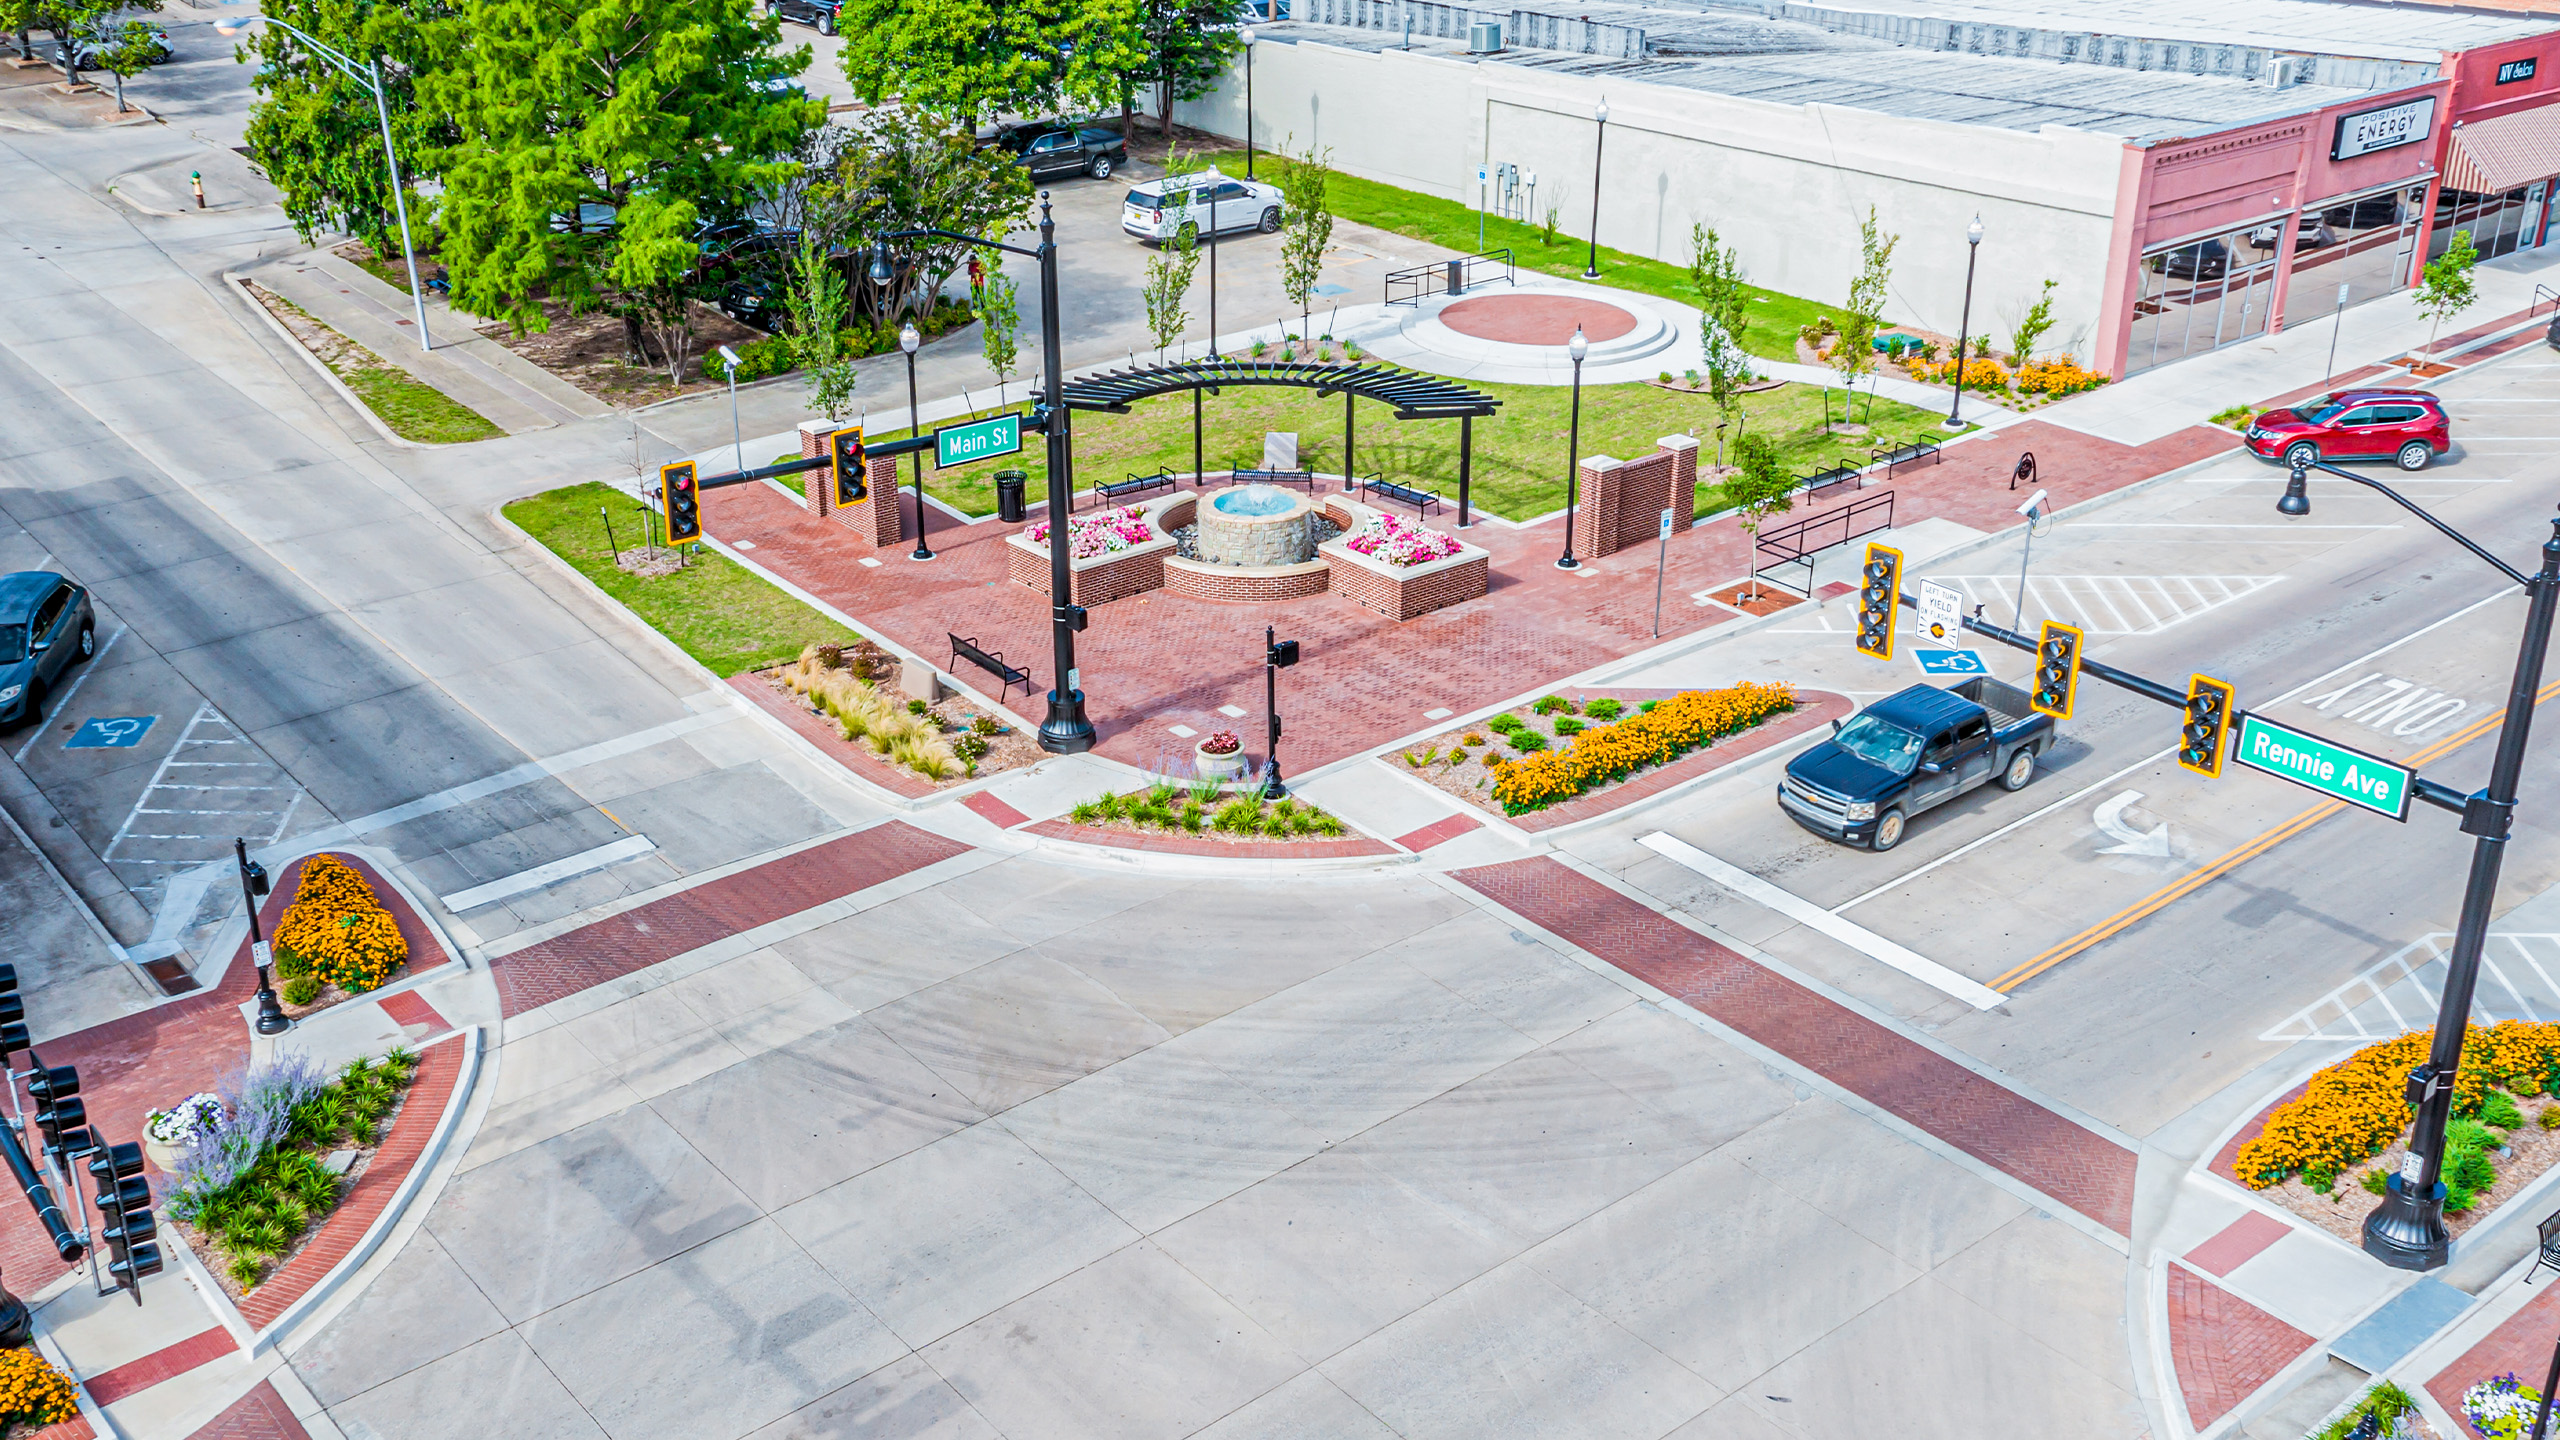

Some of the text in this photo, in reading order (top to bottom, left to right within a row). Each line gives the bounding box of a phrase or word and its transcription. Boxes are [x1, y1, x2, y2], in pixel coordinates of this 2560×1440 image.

[2499, 62, 2533, 81] NV Salon
[2362, 104, 2417, 124] POSITIVE
[2357, 114, 2417, 142] ENERGY
[949, 427, 1009, 456] Main St
[1926, 586, 1958, 602] LEFT TURN
[1930, 598, 1952, 613] YIELD
[1921, 607, 1958, 626] ON FLASHING
[2301, 672, 2467, 736] ONLY
[2253, 731, 2390, 801] Rennie Ave
